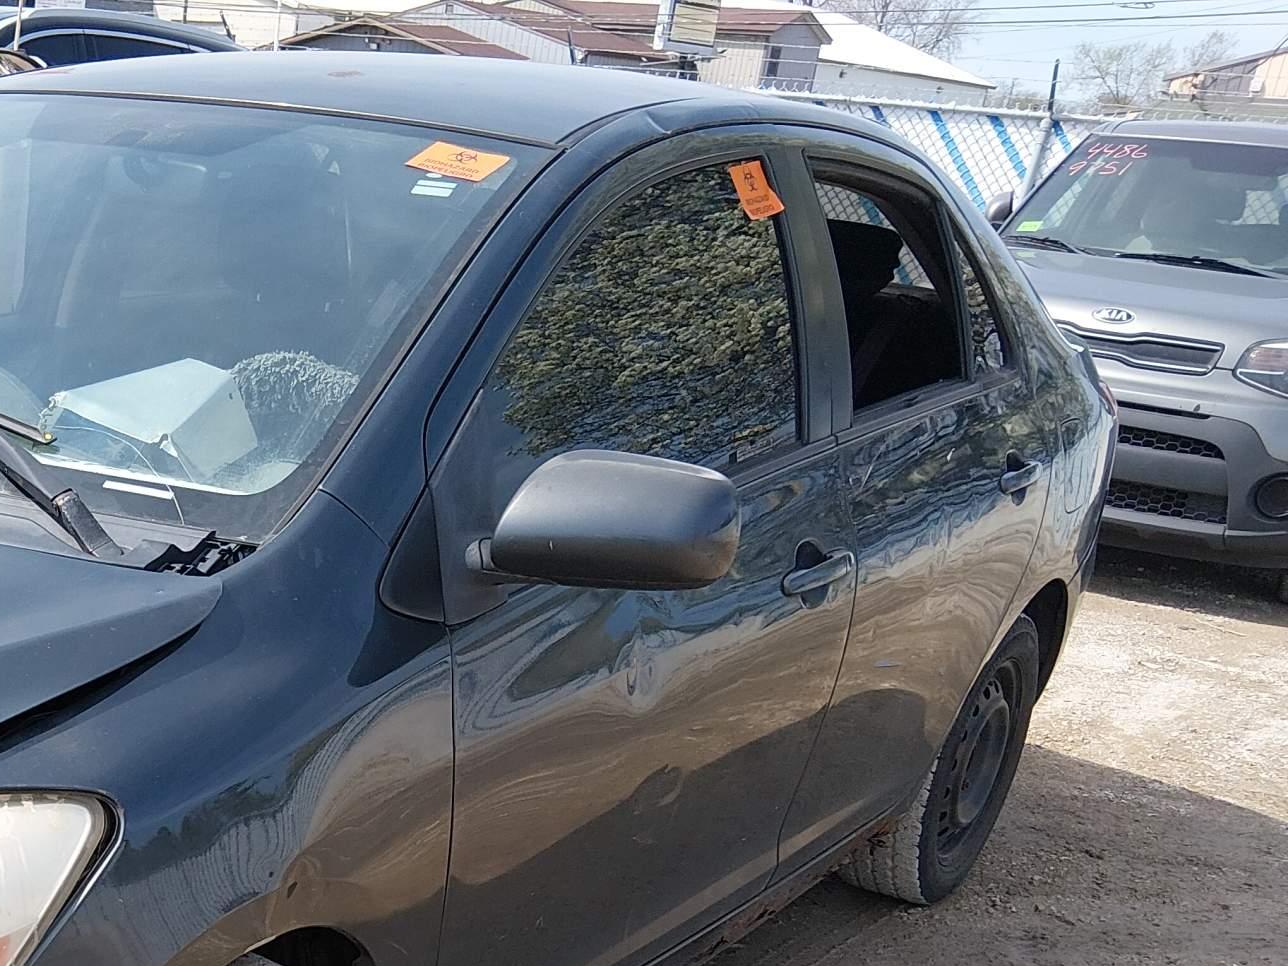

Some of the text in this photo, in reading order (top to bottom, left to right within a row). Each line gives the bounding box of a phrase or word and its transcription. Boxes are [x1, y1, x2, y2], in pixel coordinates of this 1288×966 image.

[1087, 143, 1148, 160] 4486
[423, 158, 480, 174] BIOHAZARD
[1068, 160, 1133, 176] 9751
[1094, 308, 1131, 322] KIA
